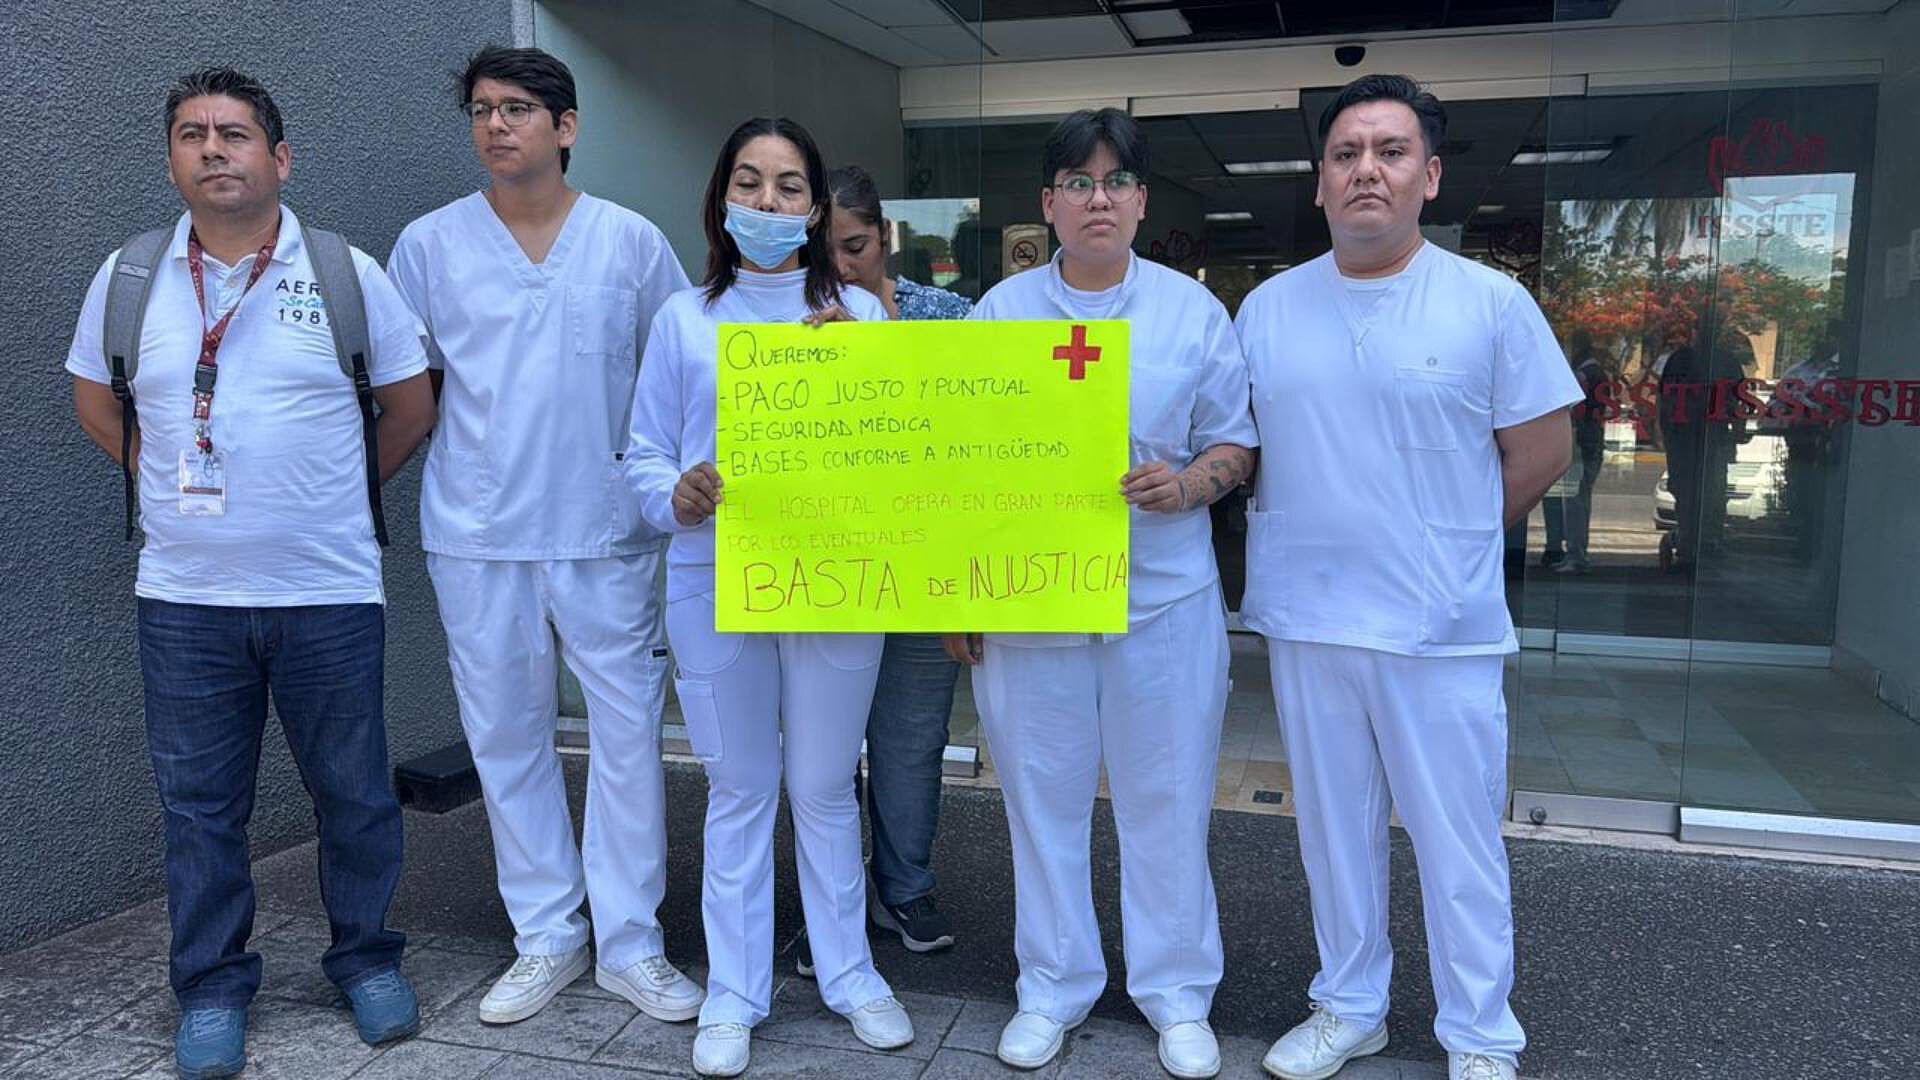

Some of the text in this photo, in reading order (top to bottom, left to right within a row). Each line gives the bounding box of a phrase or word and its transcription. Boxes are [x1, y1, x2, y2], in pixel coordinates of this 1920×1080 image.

[827, 379, 905, 406] JUSTO
[919, 377, 928, 399] Y
[935, 377, 1031, 397] PUNTUAL
[859, 410, 931, 436] MÉDICA
[823, 448, 911, 470] CONFORME
[924, 445, 936, 461] A
[948, 437, 1070, 461] ANTIGÜEDAD
[722, 489, 1108, 521] EL HOSPITAL OPERA EN GRAN PARTE
[728, 534, 763, 553] POR
[809, 527, 927, 550] EVENTUALES
[743, 551, 1129, 613] BASTA DE INJUSTICIA
